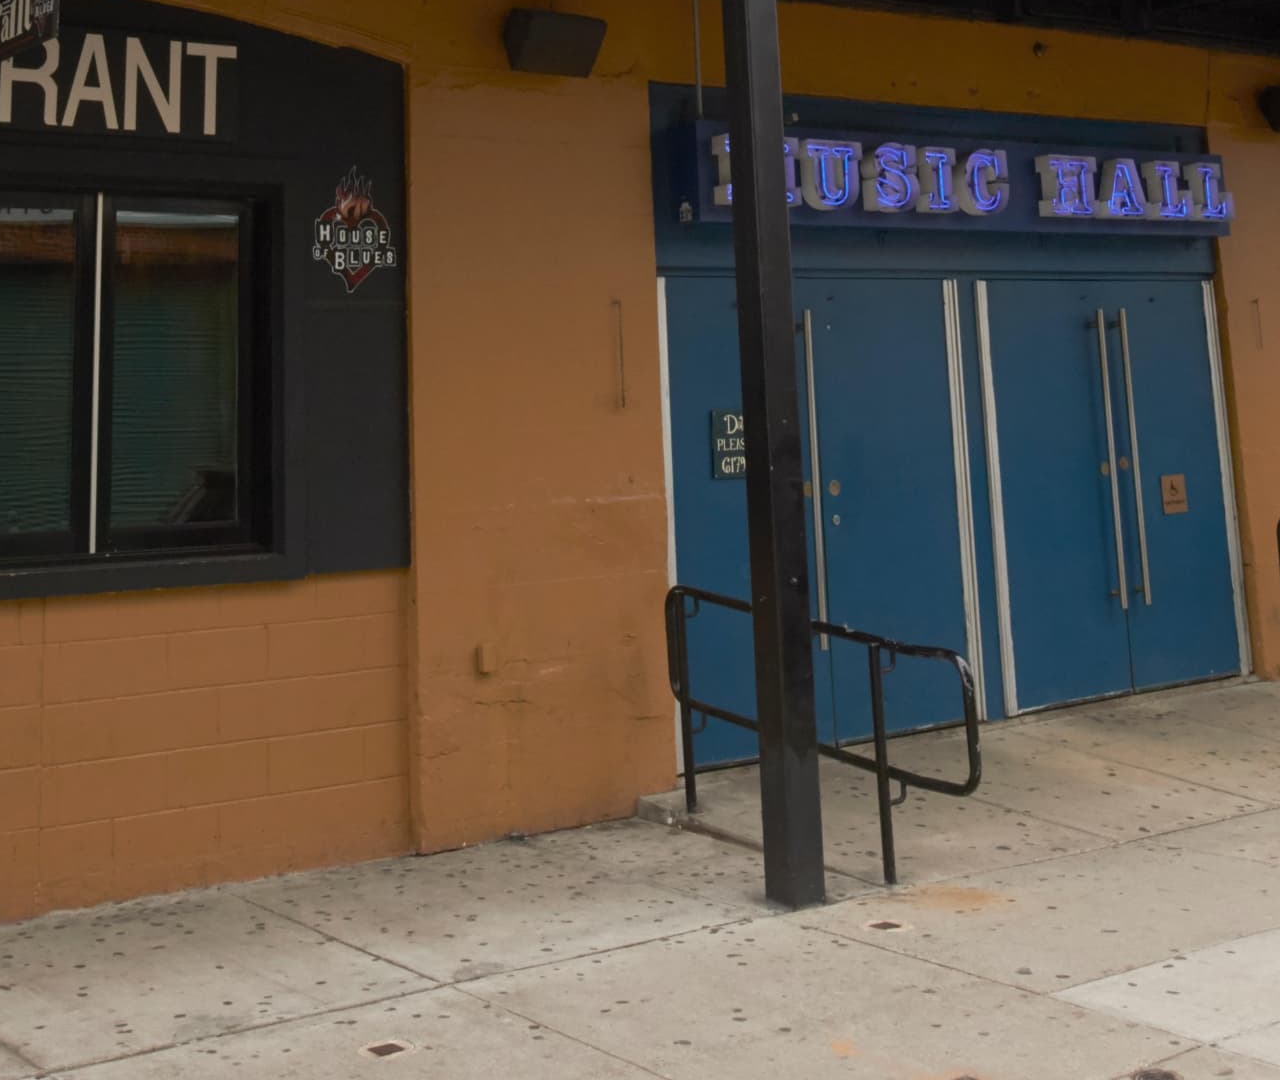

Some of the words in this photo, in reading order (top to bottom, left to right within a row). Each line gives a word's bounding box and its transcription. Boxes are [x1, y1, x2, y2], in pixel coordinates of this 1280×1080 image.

[1035, 154, 1237, 220] HALL
[320, 224, 387, 244] HOUSE
[335, 251, 393, 270] BLUES
